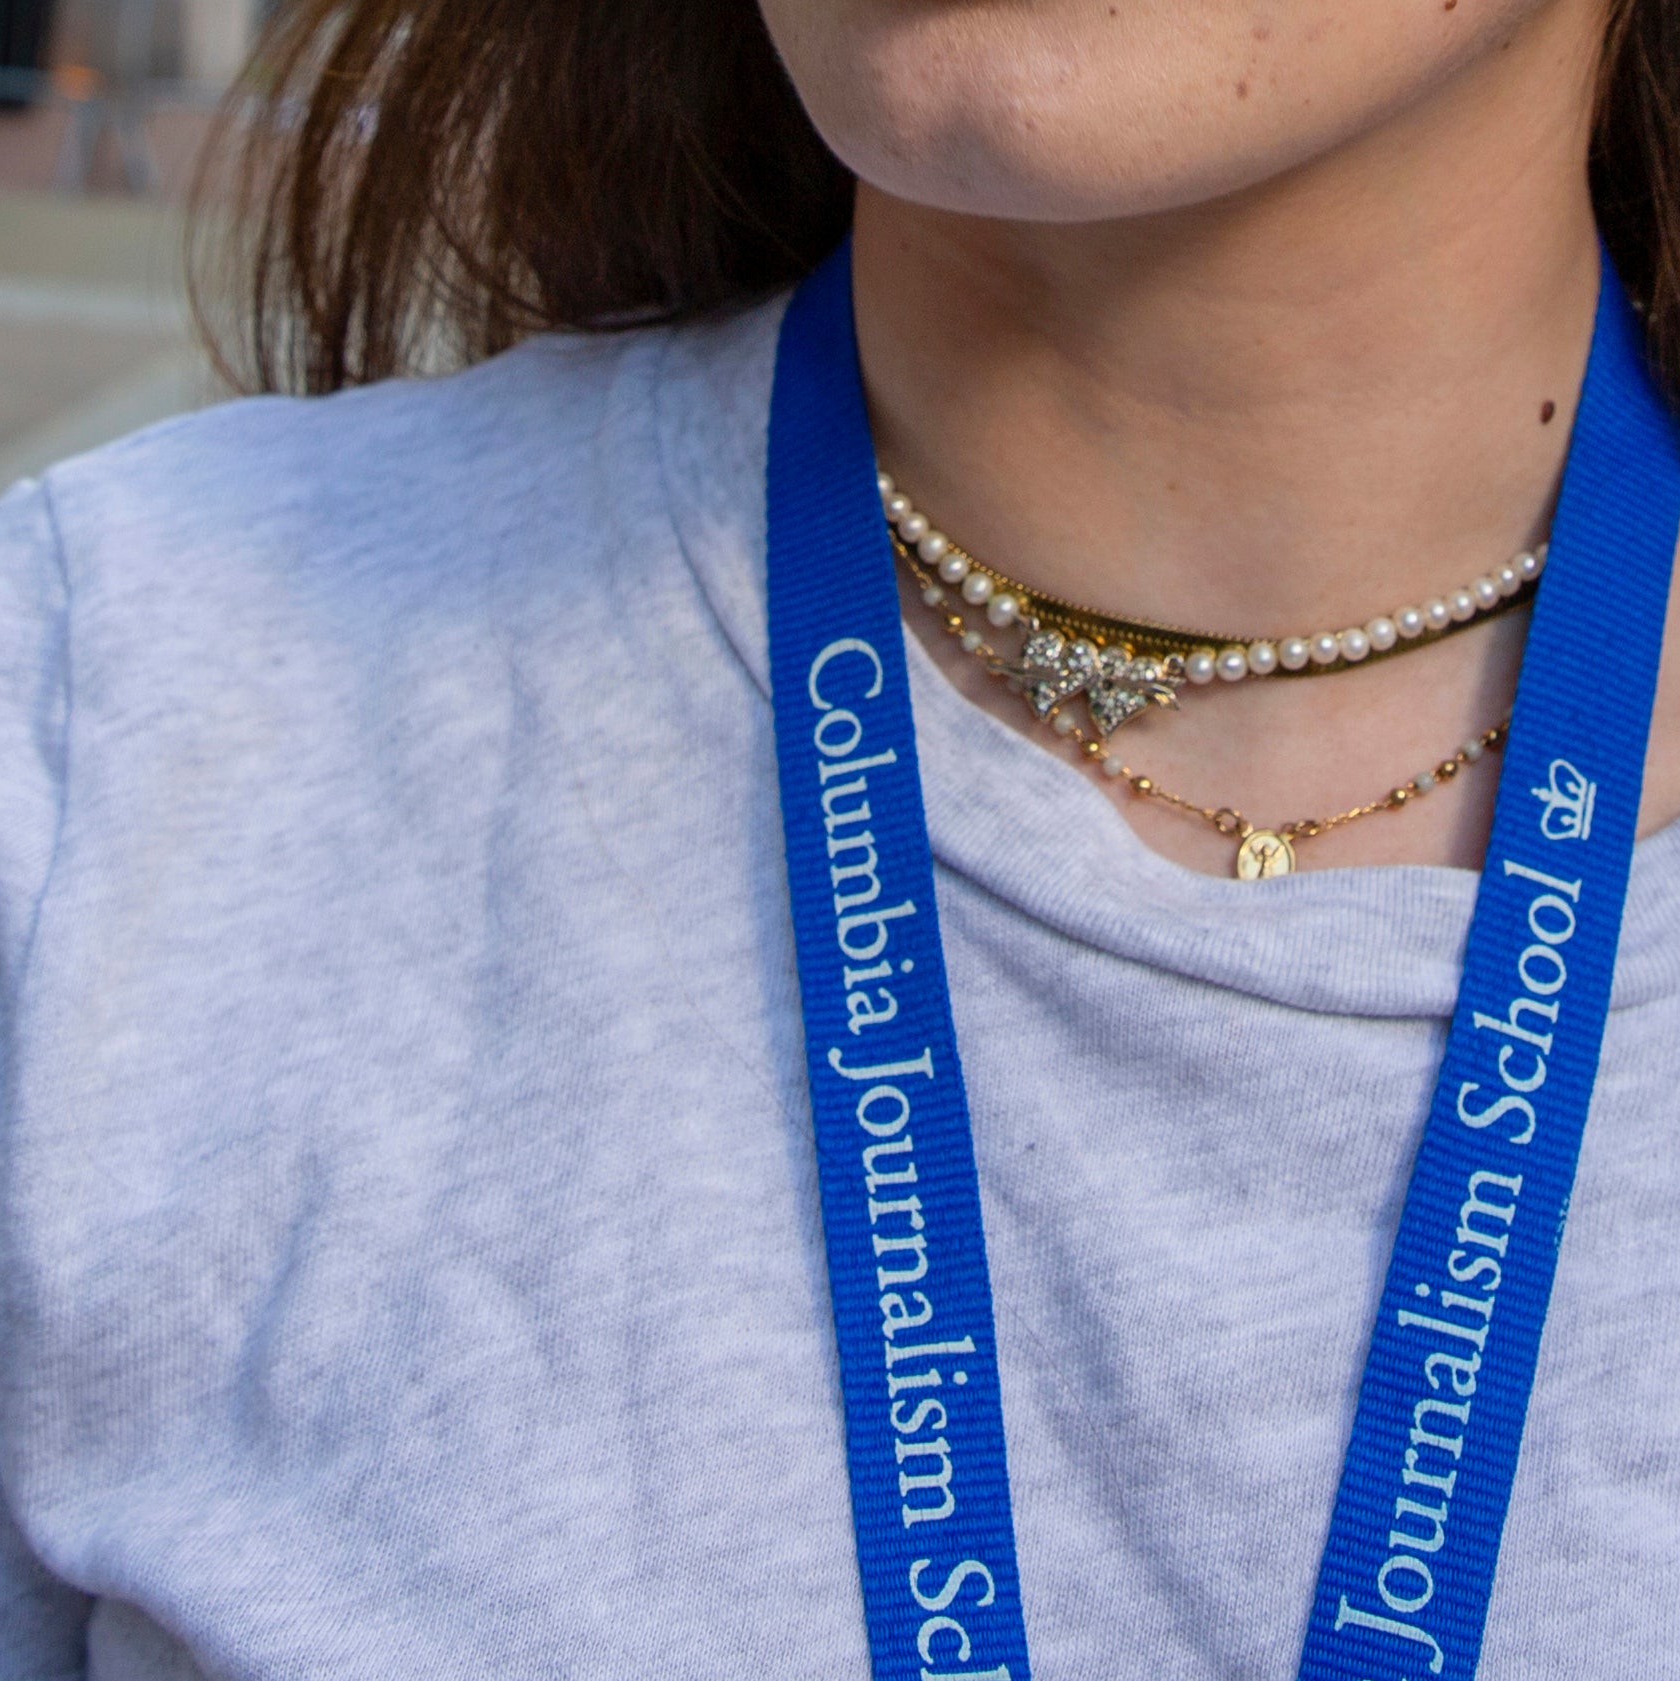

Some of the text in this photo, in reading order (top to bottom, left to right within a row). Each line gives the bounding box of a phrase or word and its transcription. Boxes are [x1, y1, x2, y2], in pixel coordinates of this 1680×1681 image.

[807, 637, 1013, 1681] Columbia Journalism Sc
[1333, 858, 1583, 1675] Journalism School
